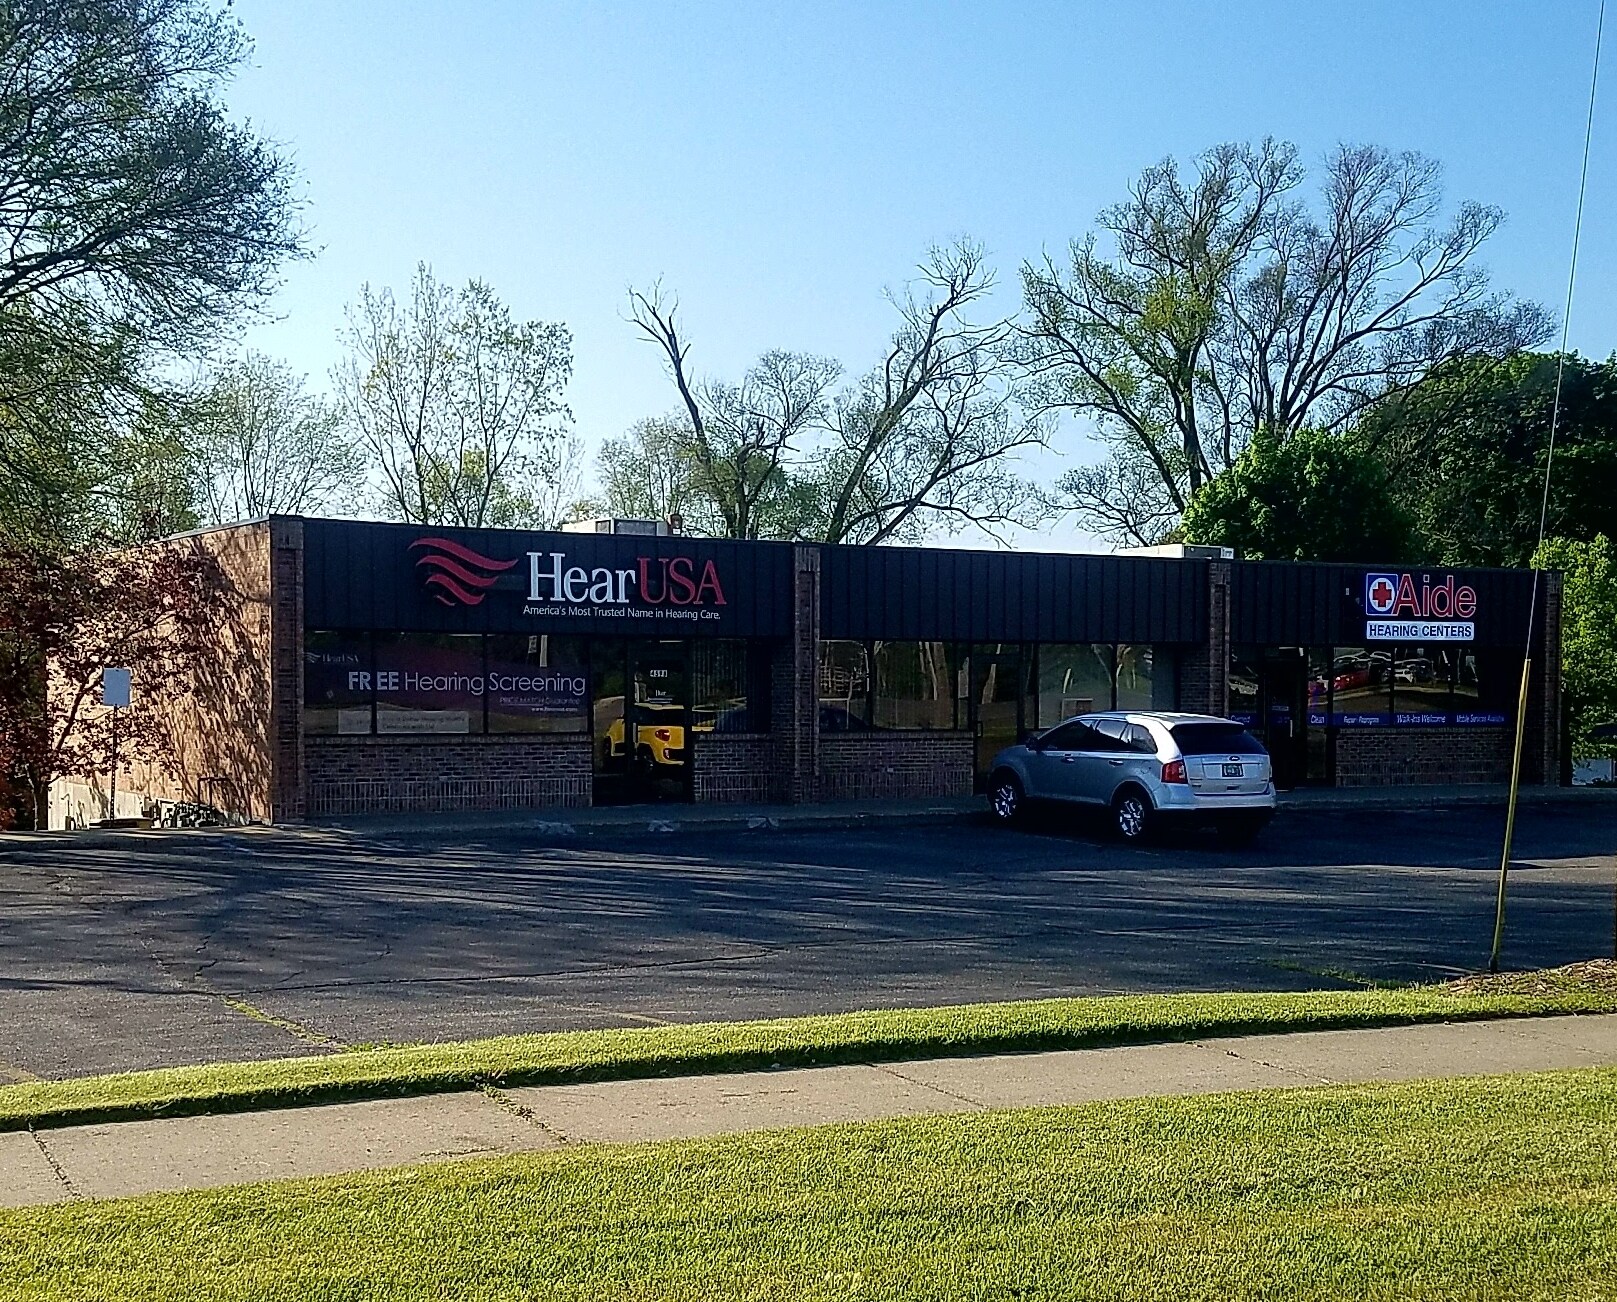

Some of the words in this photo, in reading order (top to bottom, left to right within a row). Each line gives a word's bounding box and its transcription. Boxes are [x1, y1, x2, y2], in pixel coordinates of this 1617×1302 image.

[525, 551, 728, 606] HearUSA
[1391, 573, 1477, 618] Aide
[522, 604, 567, 617] America's
[568, 606, 592, 617] Most
[593, 606, 625, 618] Trusted
[627, 607, 654, 619] Name
[655, 607, 664, 618] in
[665, 608, 698, 621] Hearing
[700, 609, 721, 620] Care.
[1369, 624, 1418, 637] HEARING
[1422, 625, 1472, 637] CENTERS
[404, 671, 484, 696] Hearing
[488, 672, 586, 697] Screening
